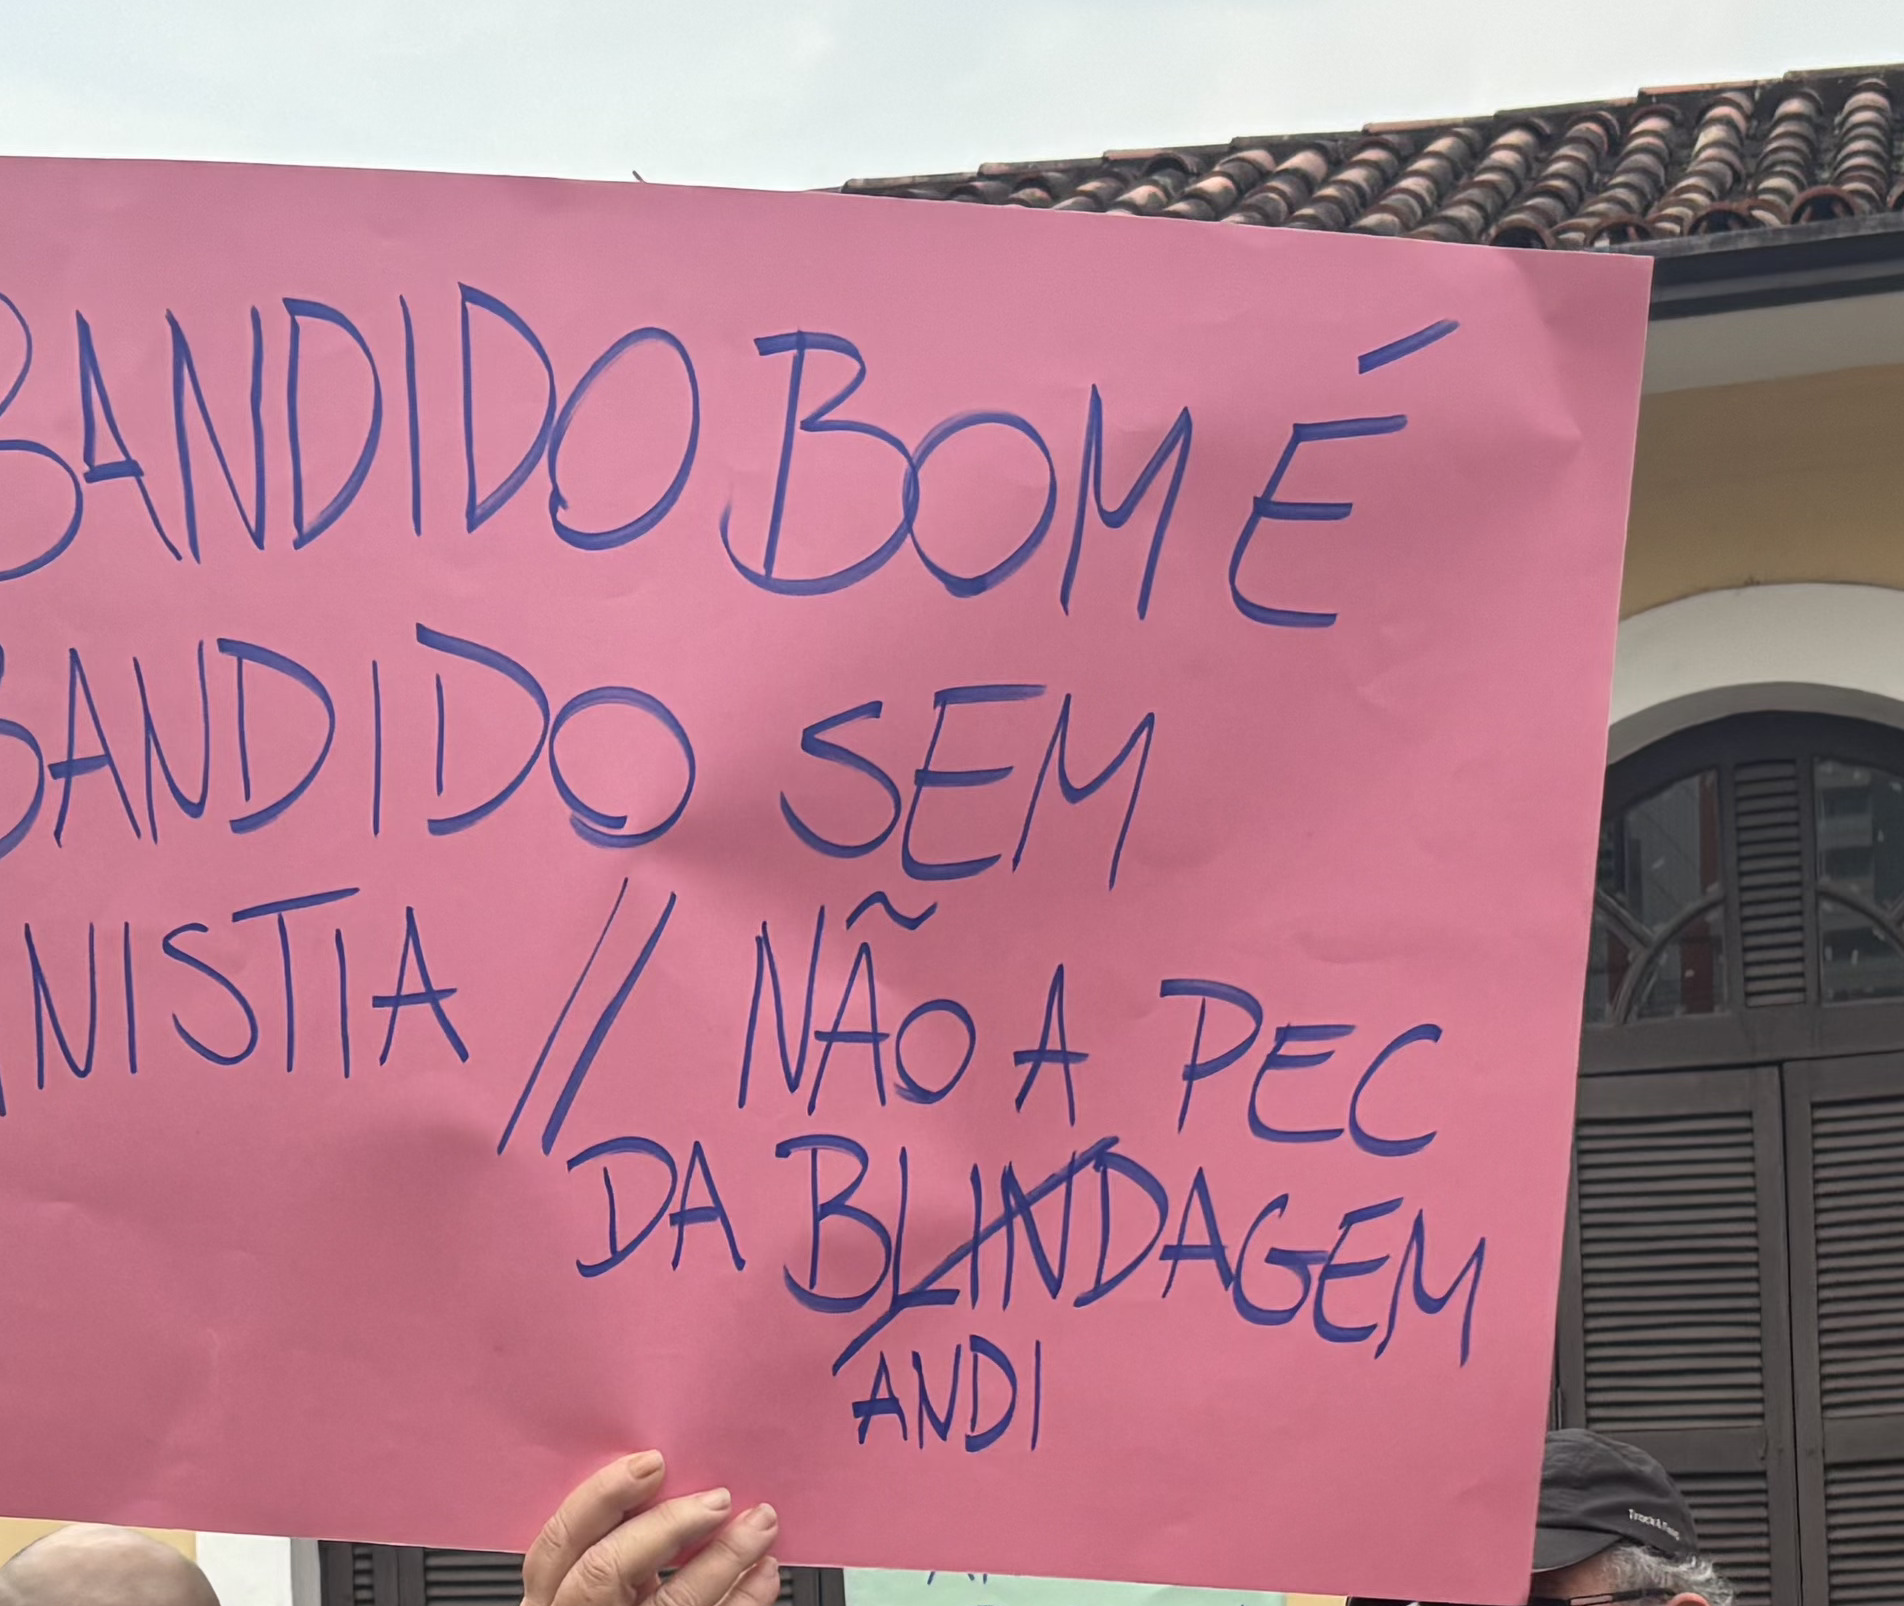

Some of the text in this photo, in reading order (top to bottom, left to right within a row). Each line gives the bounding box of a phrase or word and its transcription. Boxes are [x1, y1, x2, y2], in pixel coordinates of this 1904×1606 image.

[720, 328, 1193, 620] BOM
[1229, 319, 1460, 628] É
[780, 684, 1154, 890] SEM
[738, 891, 976, 1115] NÃO
[1014, 964, 1089, 1125] A
[1160, 978, 1442, 1157] PEC
[567, 1136, 745, 1277] DA
